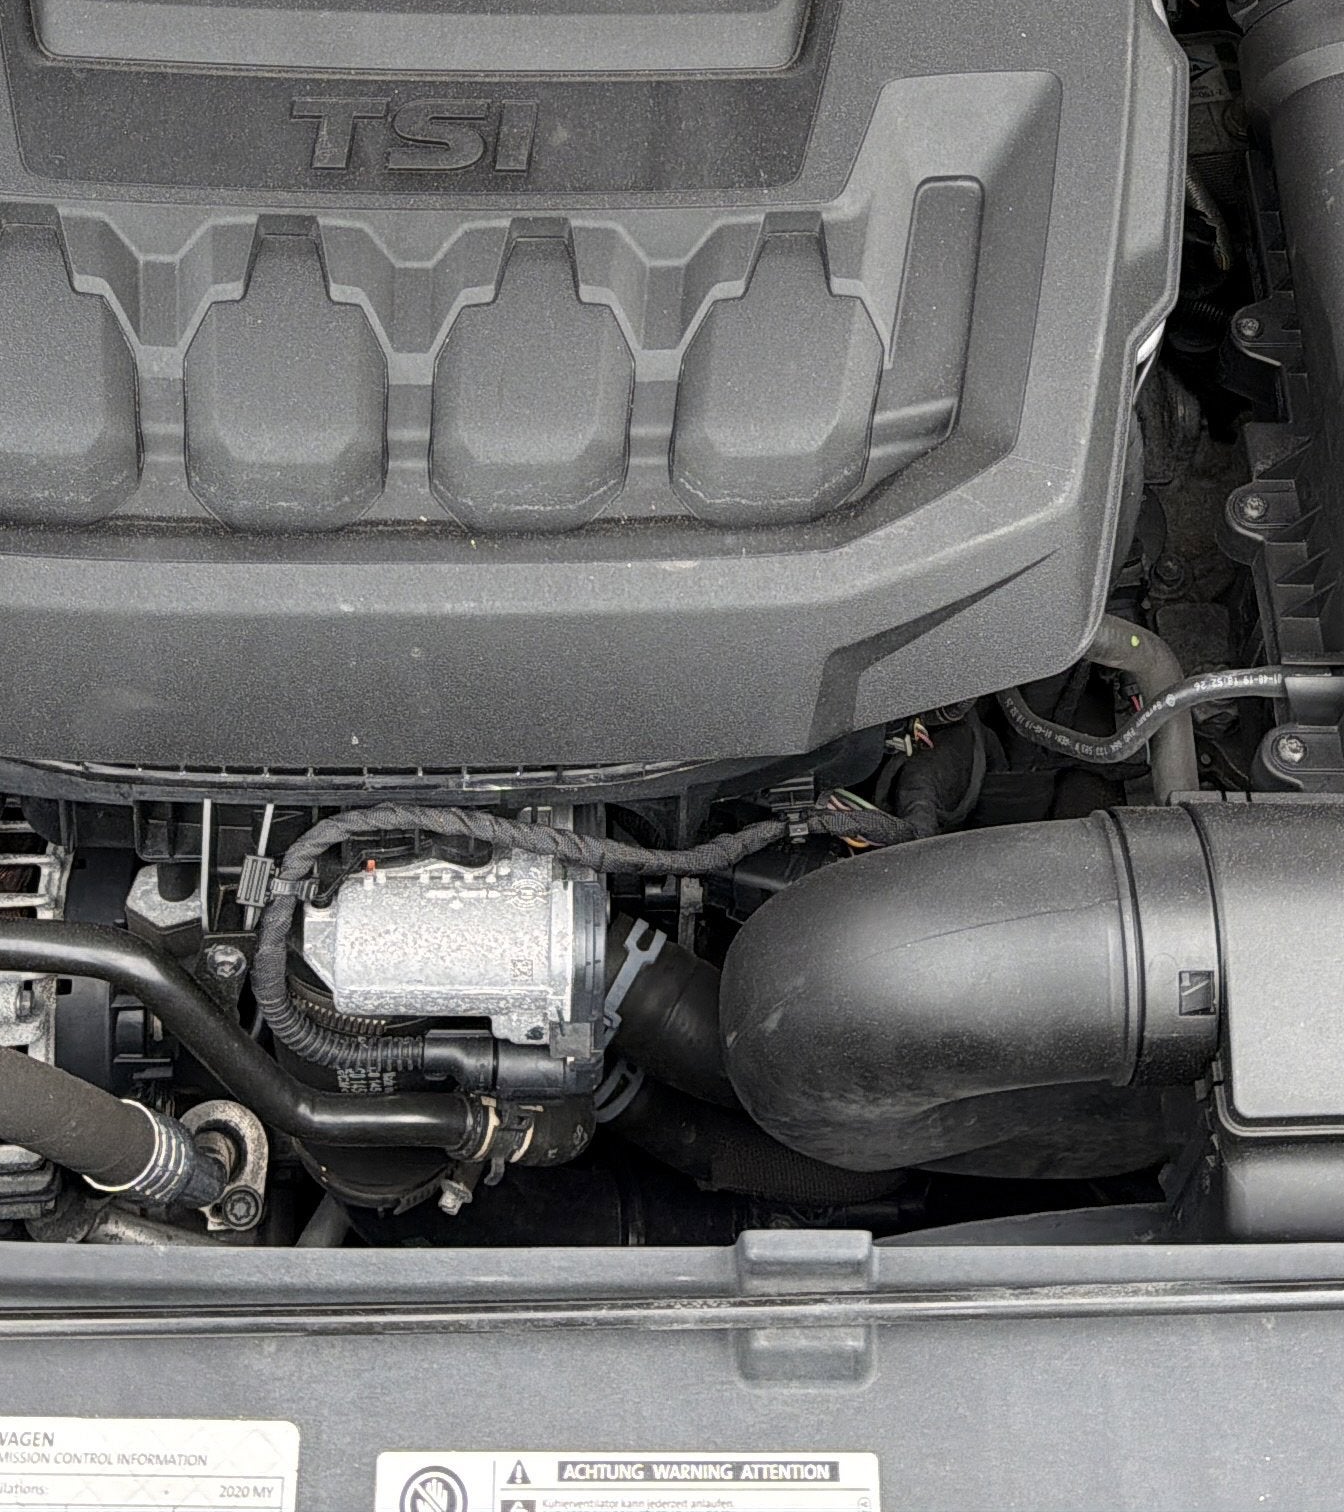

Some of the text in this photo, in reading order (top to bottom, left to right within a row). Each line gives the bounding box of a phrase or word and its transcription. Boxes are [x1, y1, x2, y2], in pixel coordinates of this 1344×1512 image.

[290, 96, 539, 175] TSI
[53, 1452, 114, 1465] CONTROL
[116, 1453, 208, 1466] INFORMATION
[563, 1463, 830, 1480] ACHTUNG WARNING ATTENTION
[219, 1485, 250, 1498] 2020
[253, 1485, 274, 1498] MY
